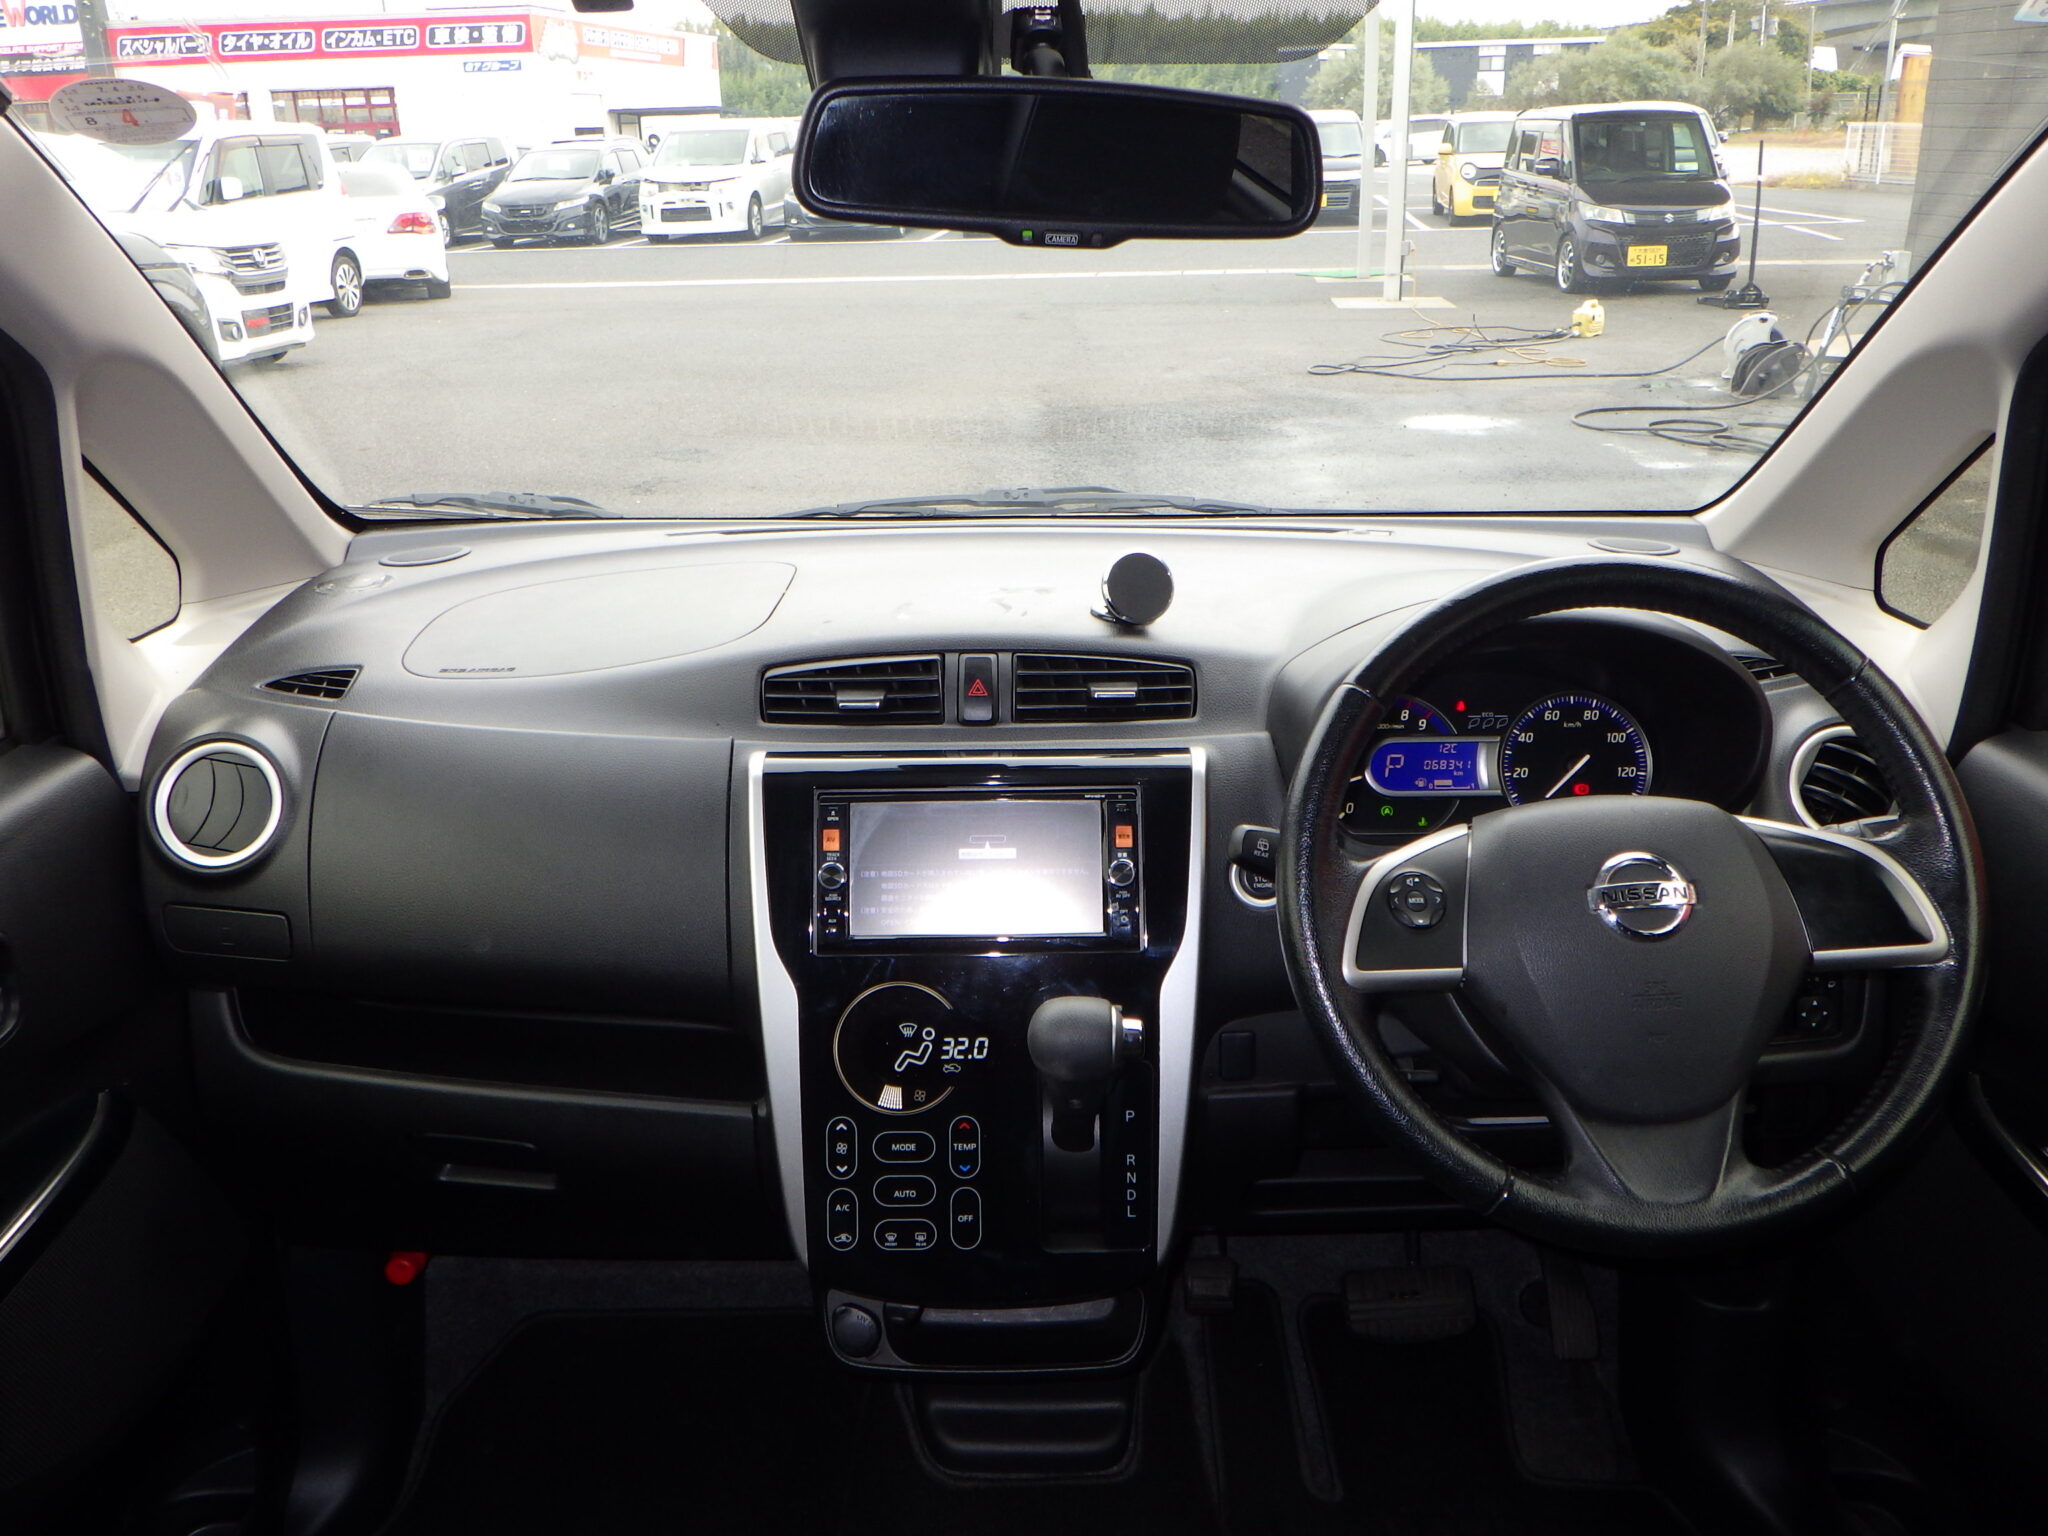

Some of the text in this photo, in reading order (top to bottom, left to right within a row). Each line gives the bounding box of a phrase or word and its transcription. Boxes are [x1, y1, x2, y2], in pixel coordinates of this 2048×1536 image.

[223, 32, 310, 52] タイヤ・オイル
[326, 28, 416, 48] インカム・ETC
[85, 117, 97, 126] 8
[120, 109, 139, 127] 4
[1047, 235, 1076, 244] CAMERA
[1636, 254, 1664, 265] 51-15
[1400, 710, 1410, 721] 8
[1544, 710, 1560, 721] 60
[1584, 710, 1600, 721] 80
[1418, 719, 1427, 731] 9
[1518, 732, 1534, 743] 40
[1607, 732, 1626, 743] 100
[1385, 754, 1405, 778] P
[1424, 760, 1472, 770] 068341
[1513, 767, 1529, 778] 20
[1617, 766, 1637, 777] 120
[1346, 802, 1354, 814] 0
[1601, 886, 1688, 903] NISSAN
[941, 1037, 989, 1060] 32.0
[1125, 1110, 1135, 1122] P
[892, 1143, 917, 1151] MODE
[953, 1143, 976, 1151] TEMP
[1126, 1154, 1136, 1166] R
[1126, 1171, 1136, 1183] N
[893, 1190, 917, 1198] AUTO
[1127, 1189, 1136, 1201] D
[835, 1204, 850, 1212] A/C
[1127, 1205, 1136, 1217] L
[957, 1215, 974, 1223] OFF
